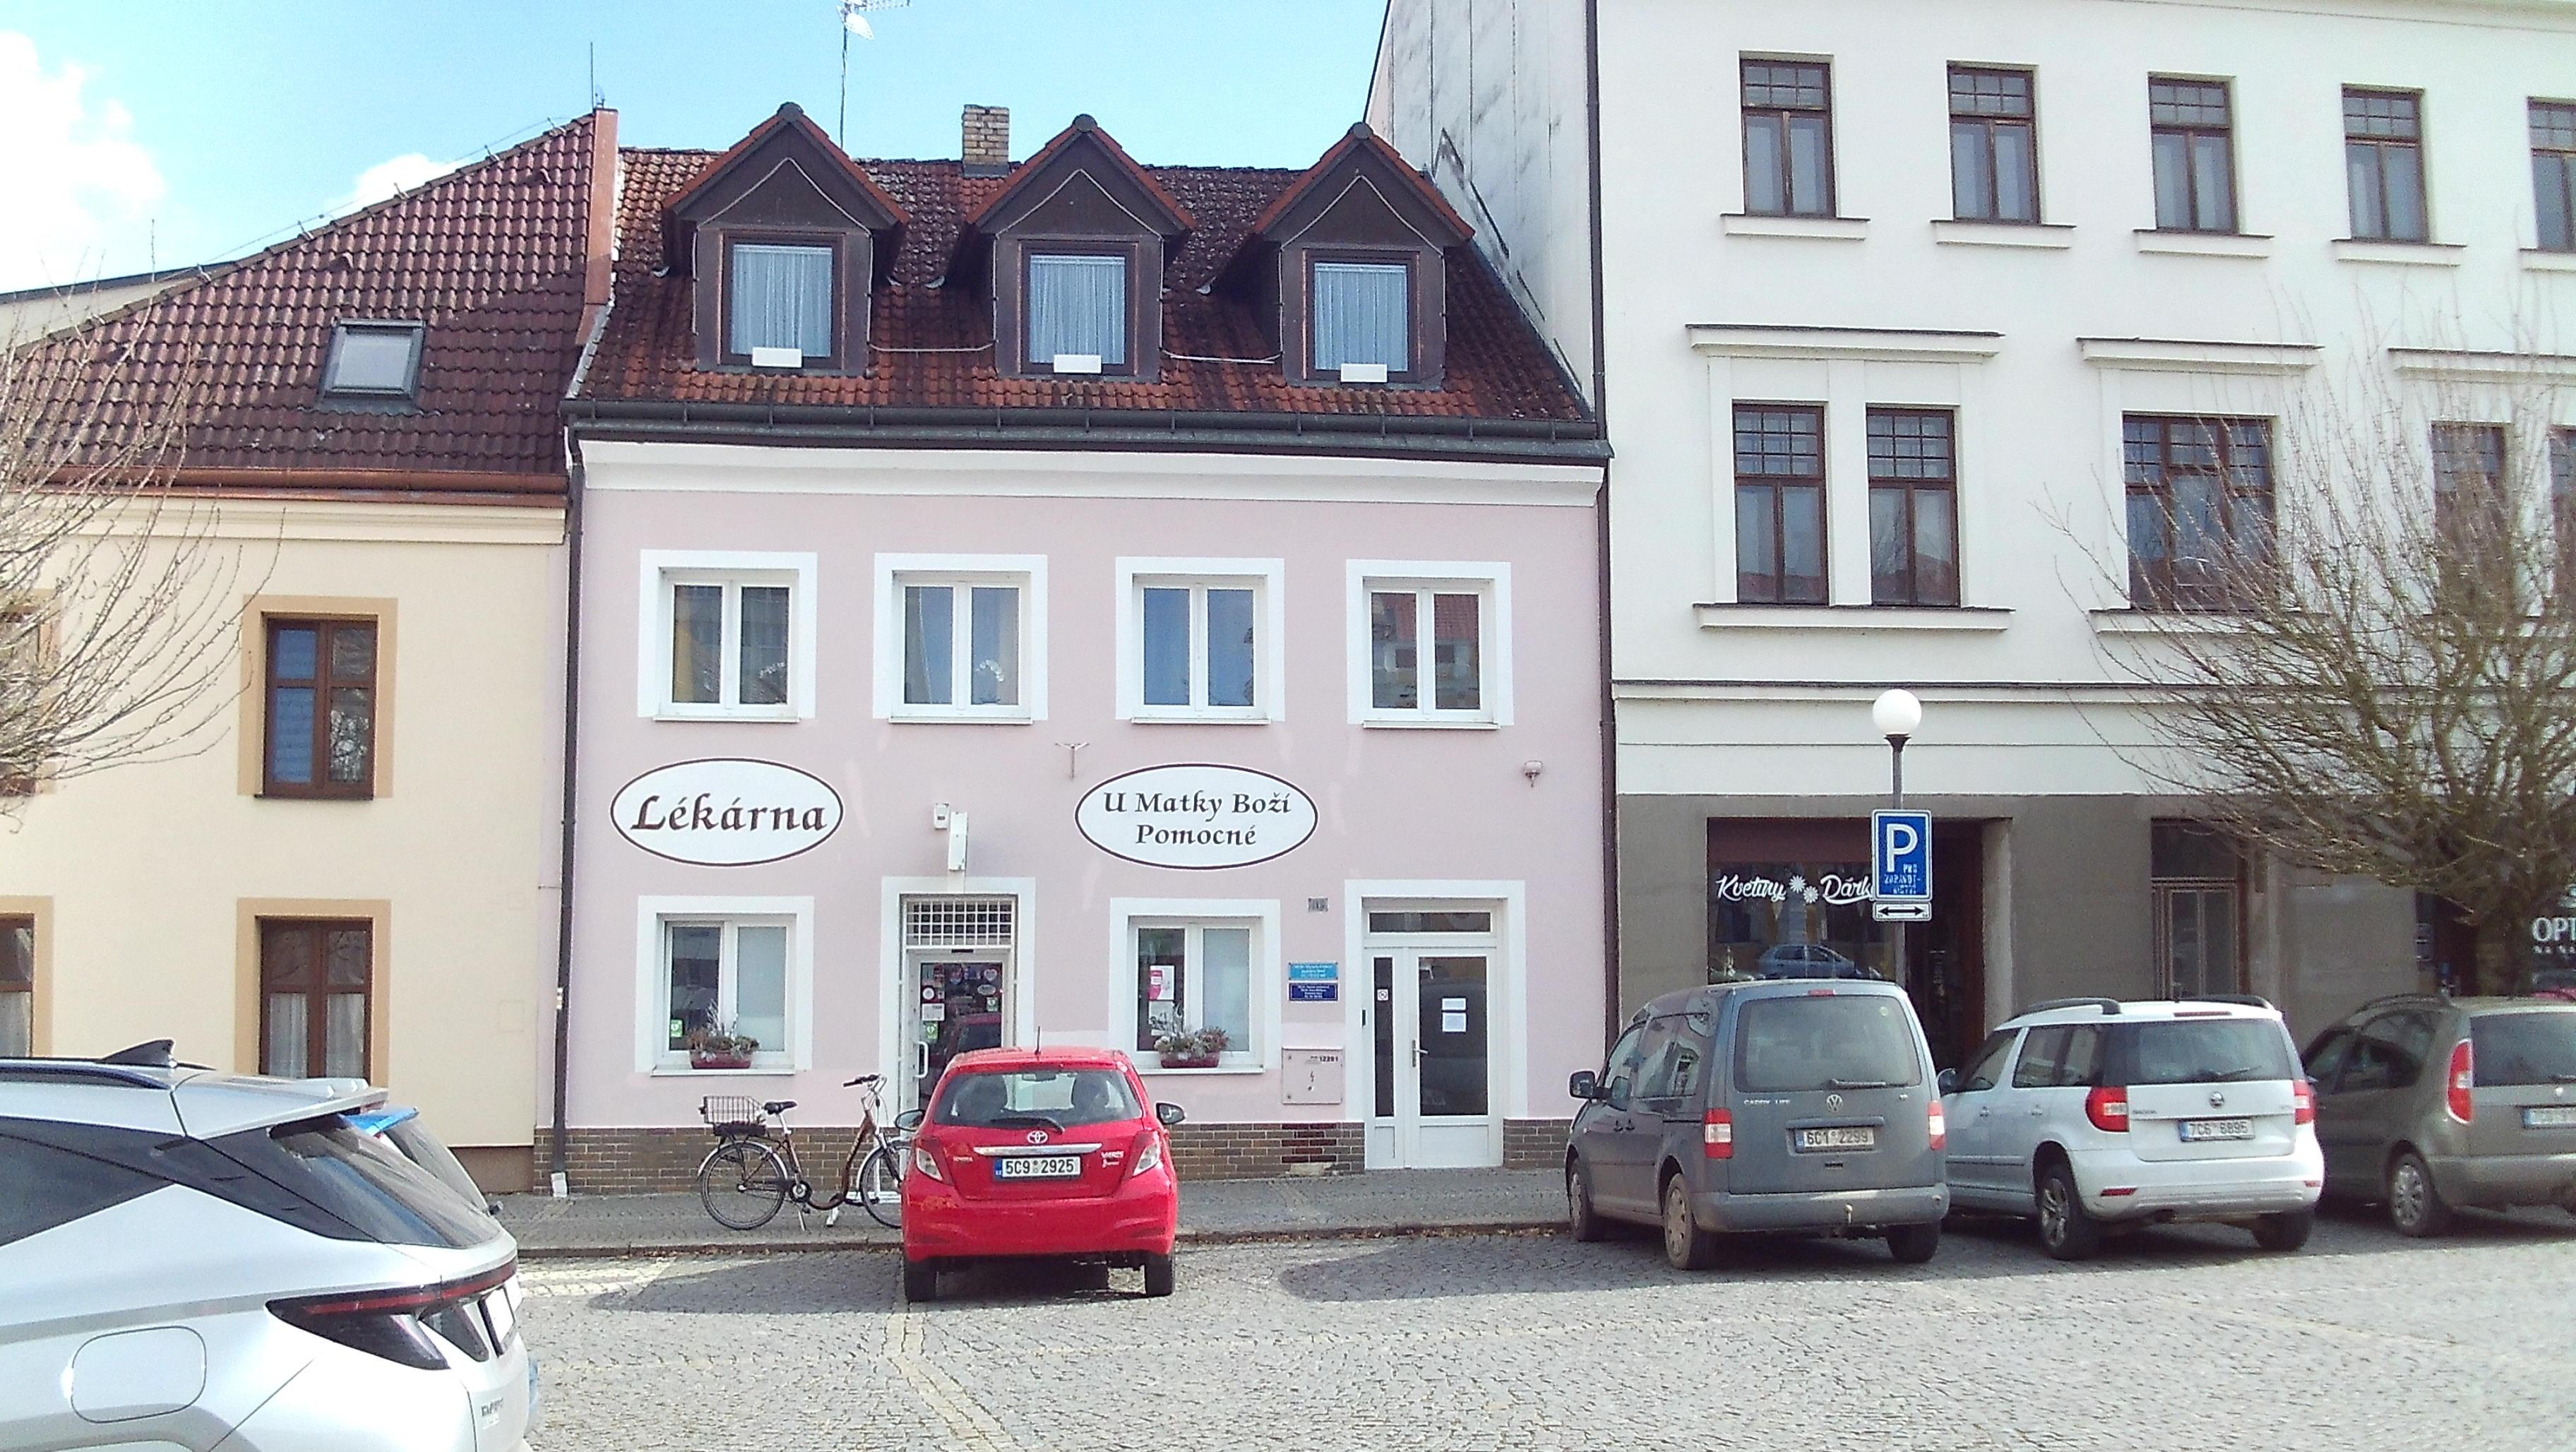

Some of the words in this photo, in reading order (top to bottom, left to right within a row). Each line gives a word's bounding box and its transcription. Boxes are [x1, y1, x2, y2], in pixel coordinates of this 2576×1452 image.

[630, 792, 827, 832] Lékárna
[1104, 791, 1126, 813] U
[1135, 790, 1222, 821] Matky
[1232, 792, 1292, 814] Boží
[1135, 824, 1256, 845] Pomocné
[1886, 823, 1918, 873] P
[1806, 1131, 1830, 1144] 6C1
[1839, 1130, 1868, 1143] 2299
[1006, 1161, 1030, 1174] 5C9
[1042, 1160, 1075, 1173] 2925
